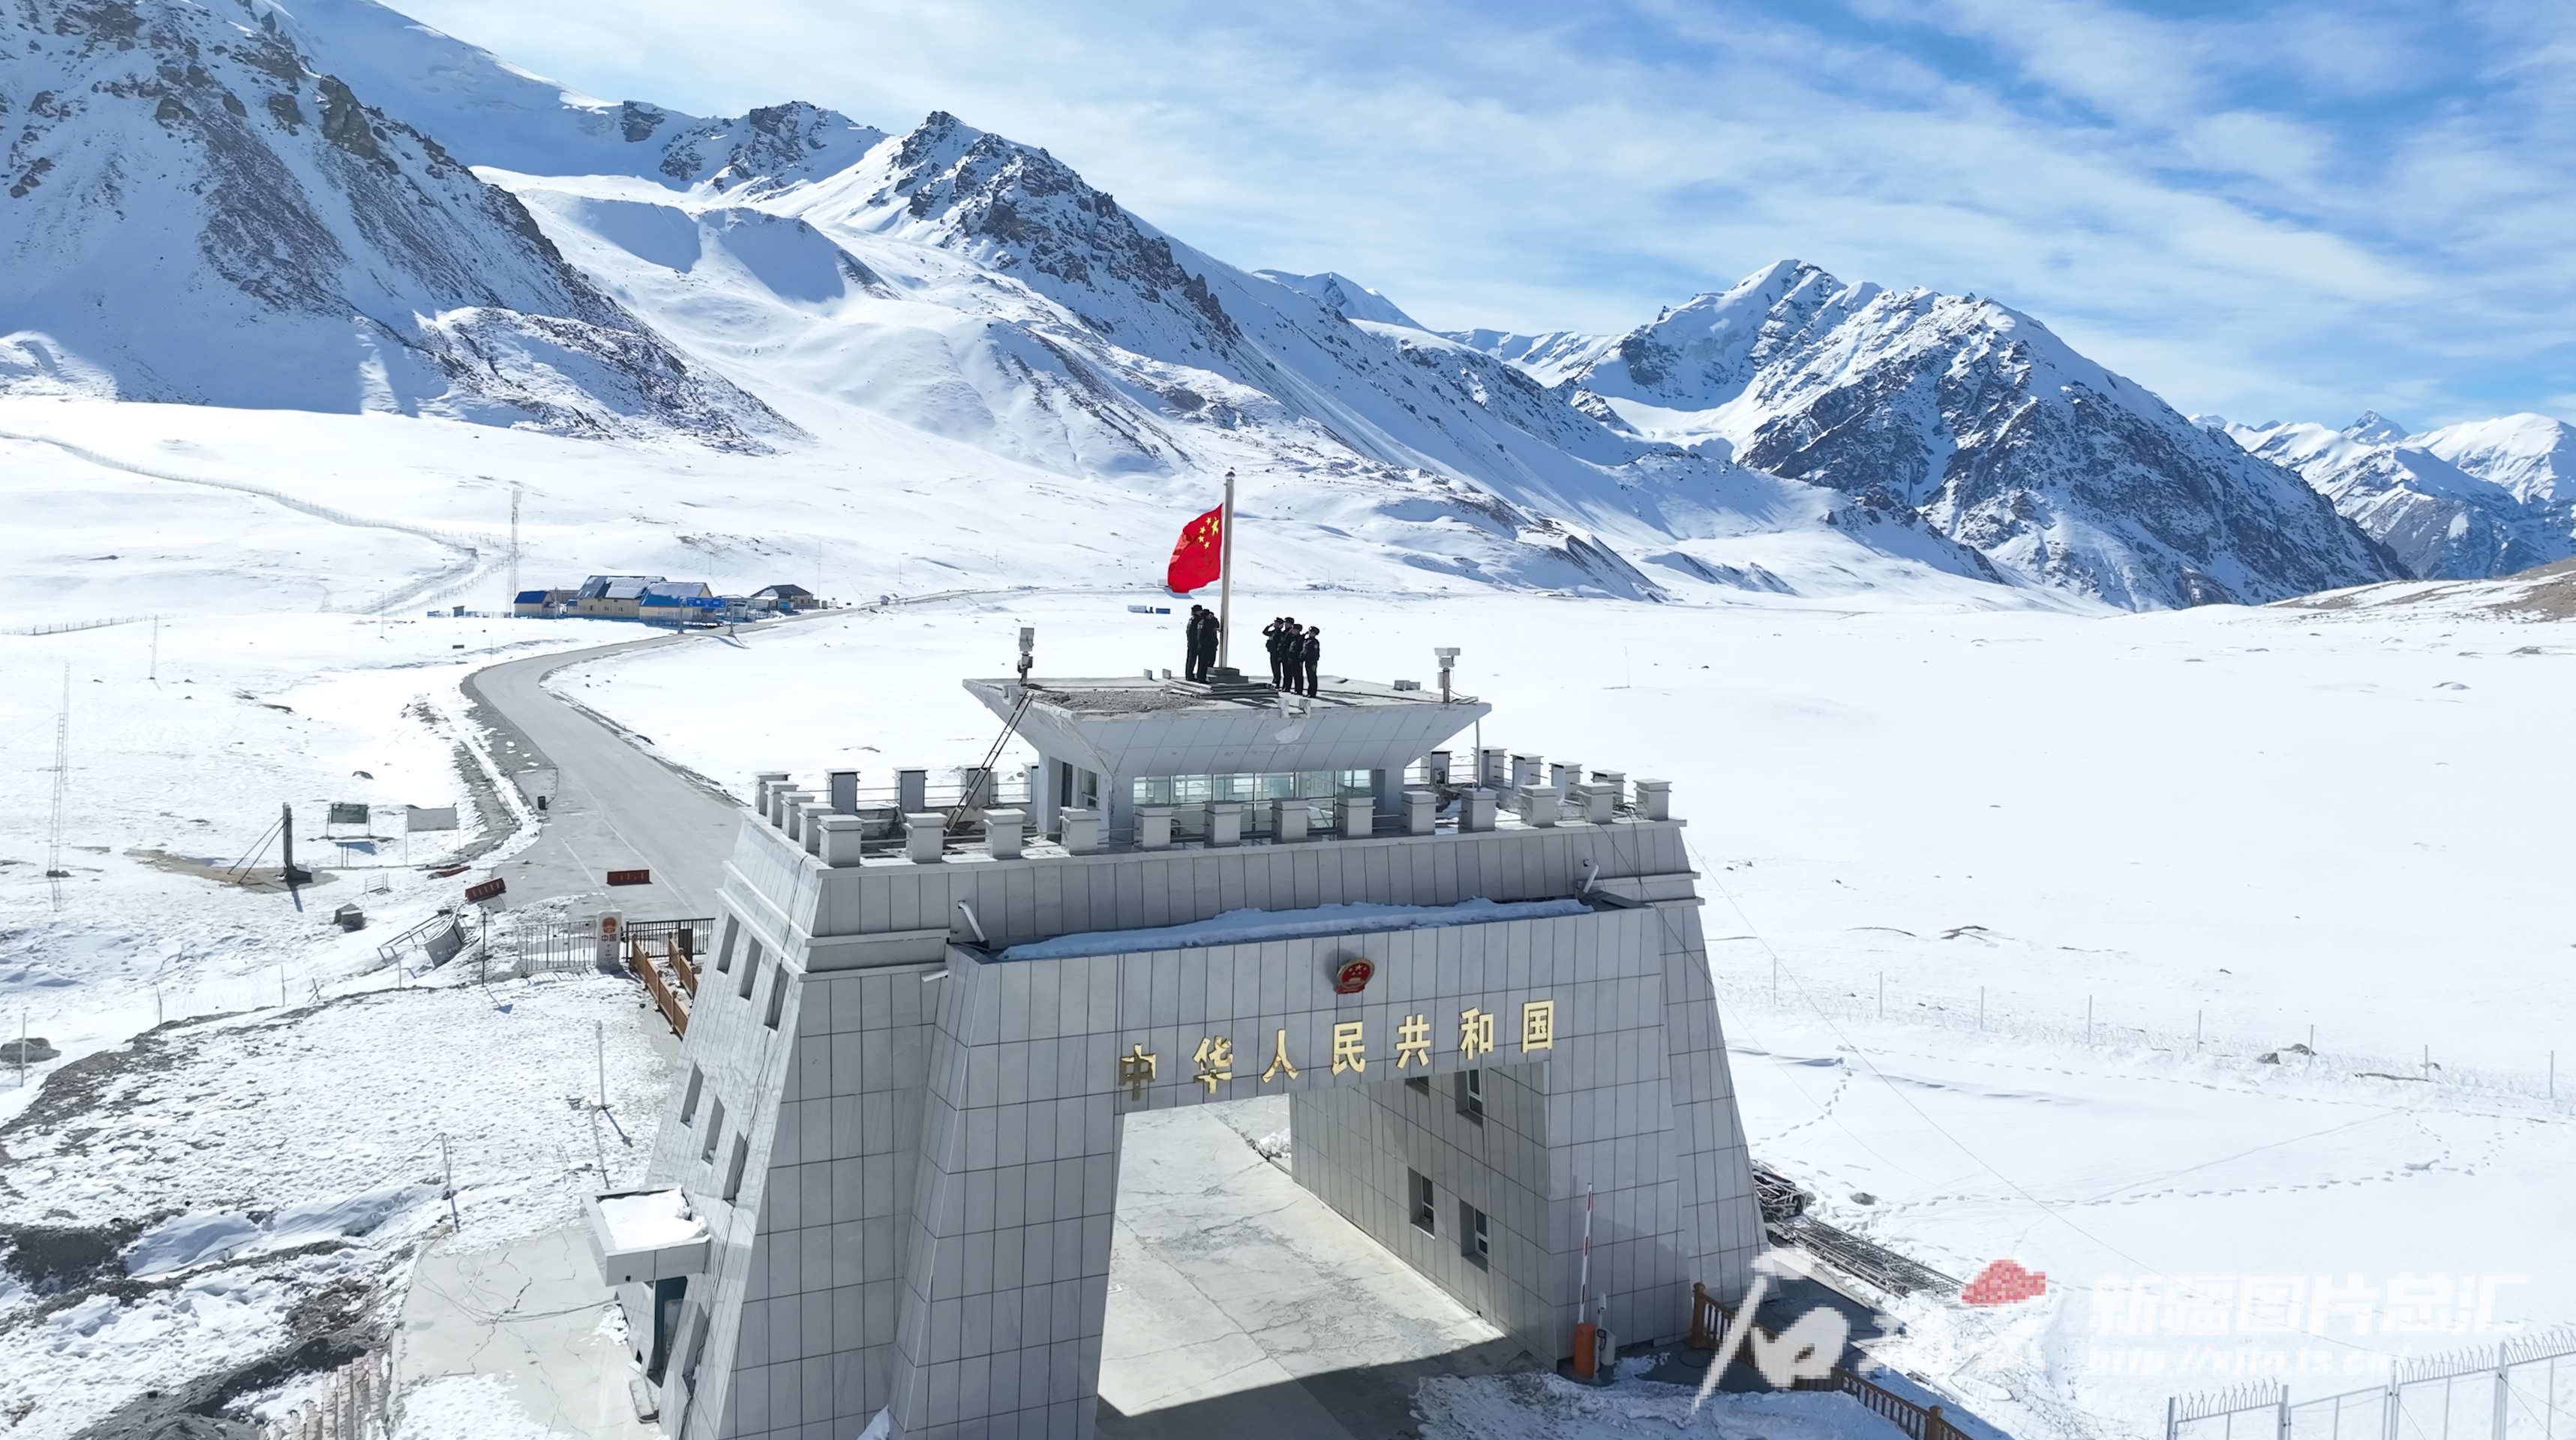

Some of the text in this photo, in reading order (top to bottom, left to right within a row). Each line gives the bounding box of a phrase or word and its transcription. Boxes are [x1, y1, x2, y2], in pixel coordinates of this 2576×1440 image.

[1119, 999, 1554, 1101] 中华人民共和国
